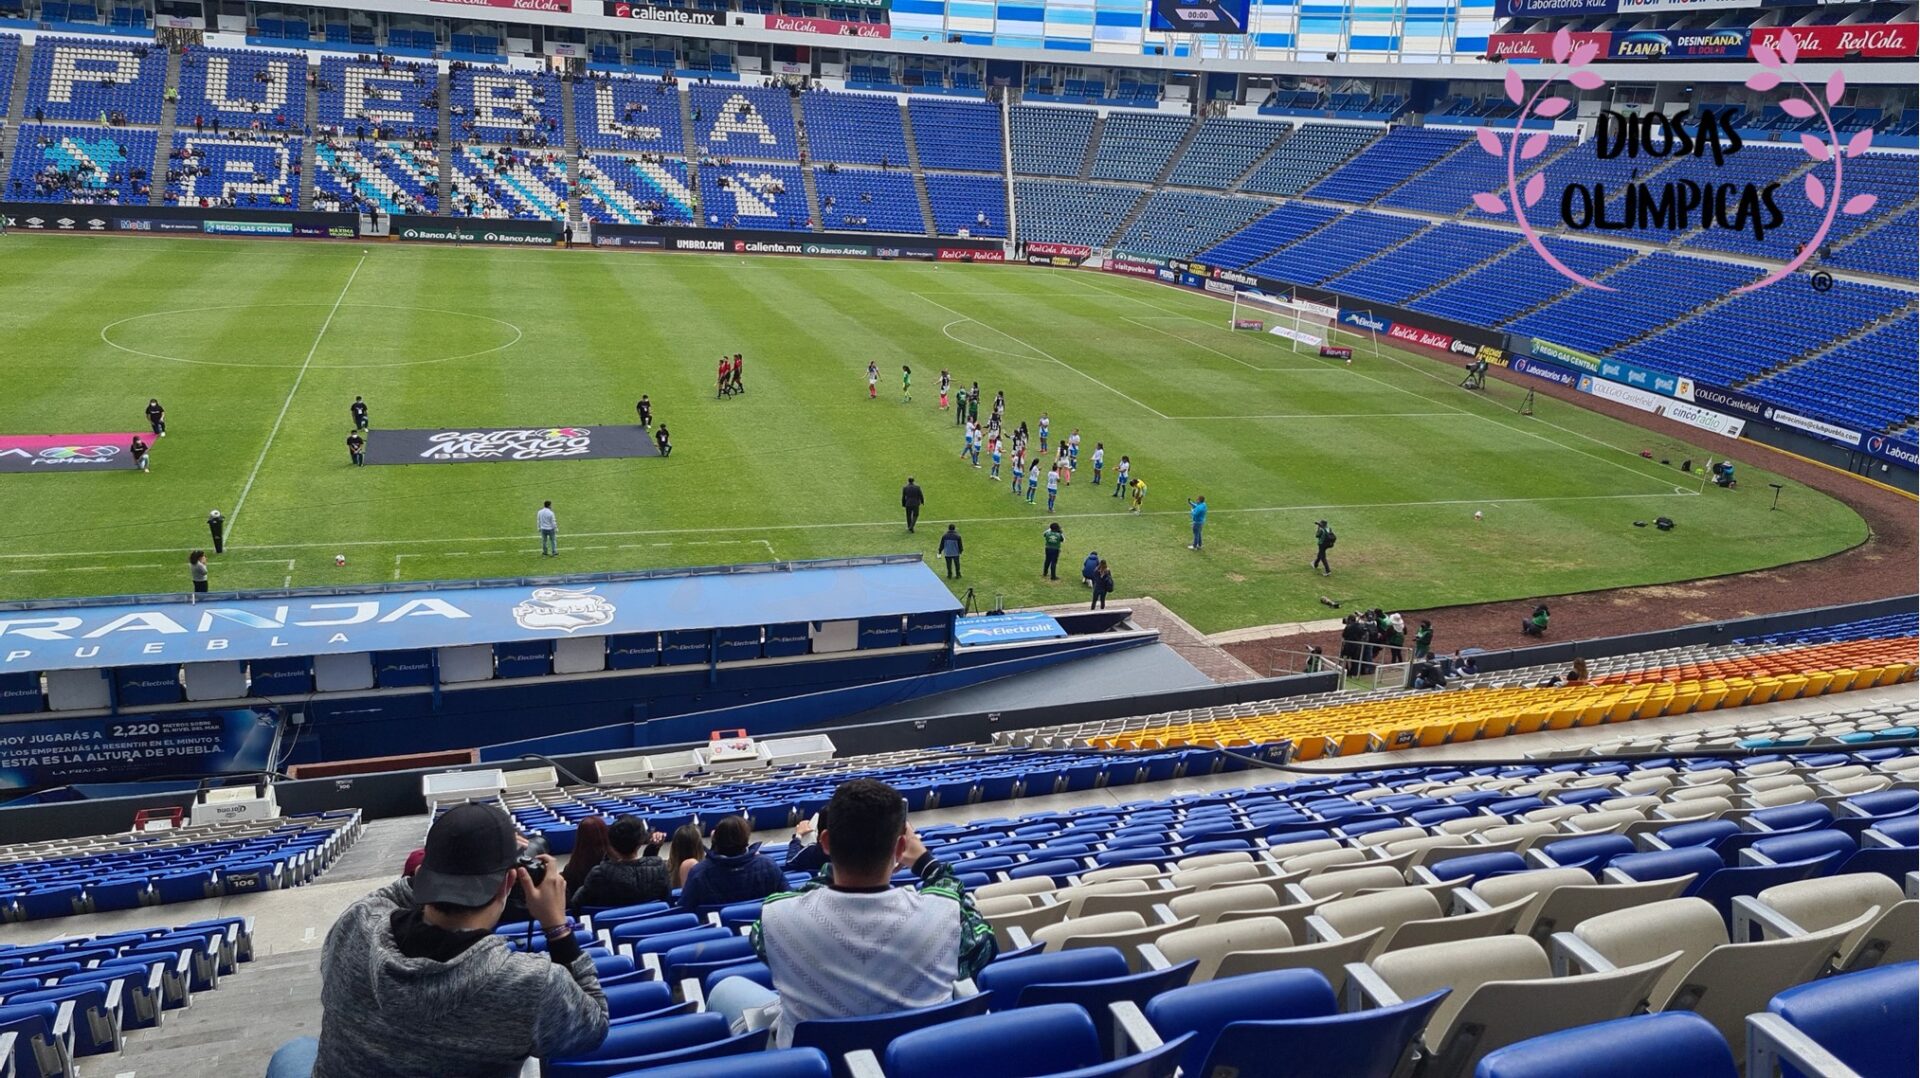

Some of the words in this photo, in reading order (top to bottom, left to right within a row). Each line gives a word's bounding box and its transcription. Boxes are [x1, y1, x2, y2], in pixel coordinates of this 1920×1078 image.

[631, 6, 715, 25] caliente.mx
[120, 219, 151, 231] Mobil
[216, 224, 239, 232] REGIO
[241, 225, 255, 233] GAS
[257, 225, 291, 234] CENTRAL
[419, 231, 445, 239] Banco
[445, 232, 474, 240] Azeca
[499, 234, 524, 242] Banco
[525, 235, 552, 243] Azteca
[676, 239, 725, 250] UMBRO.COM
[745, 241, 802, 253] caliente.mx
[820, 247, 842, 255] Banco
[843, 248, 867, 256] Azteca
[1127, 254, 1145, 263] Banco
[1451, 339, 1477, 356] Corona
[1539, 345, 1557, 357] REGIO
[1570, 356, 1598, 373] CENTRAL
[1526, 363, 1561, 382] Laboratorios
[1695, 388, 1725, 405] COLEGIO
[1726, 396, 1760, 414] Castlefield
[1885, 444, 1919, 466] Laborat
[0, 598, 472, 640] RANJA
[991, 623, 1054, 636] Electrolit
[142, 680, 175, 688] Electrolit
[0, 736, 25, 746] HOY
[29, 730, 89, 743] JUGARÁS
[92, 731, 103, 740] A
[113, 723, 160, 738] 2,220
[10, 749, 29, 757] LOS
[31, 743, 91, 755] EMPEZARÁS
[102, 740, 147, 750] RESENTIR
[177, 737, 212, 745] MINUTO
[2, 758, 39, 768] ESTA
[42, 756, 60, 765] ES
[64, 753, 82, 763] LA
[86, 749, 142, 762] ALTURA
[145, 748, 164, 758] DE
[233, 879, 255, 888] 106
